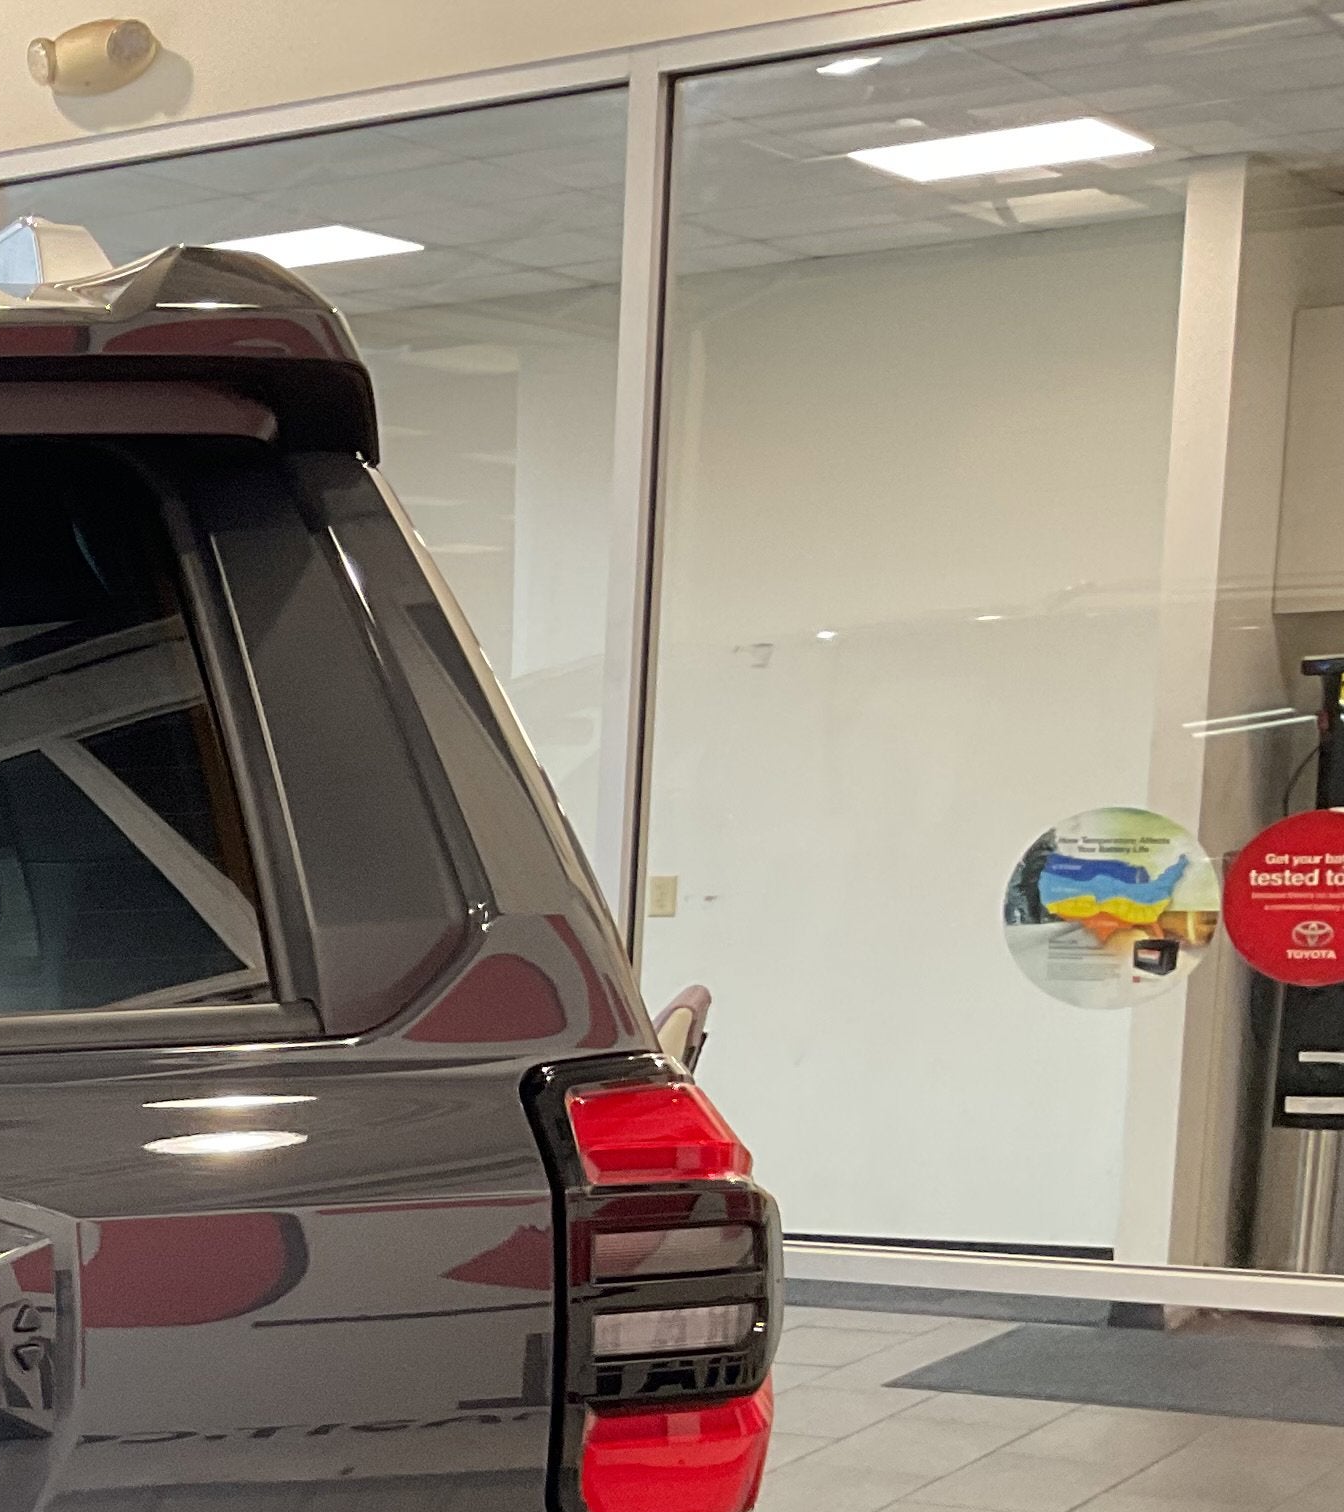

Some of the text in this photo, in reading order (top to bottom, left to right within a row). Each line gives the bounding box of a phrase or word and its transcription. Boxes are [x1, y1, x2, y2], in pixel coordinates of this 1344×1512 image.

[1265, 853, 1289, 865] Get
[1292, 854, 1323, 867] your
[1249, 868, 1320, 886] tested
[1286, 949, 1337, 960] TOYOTA
